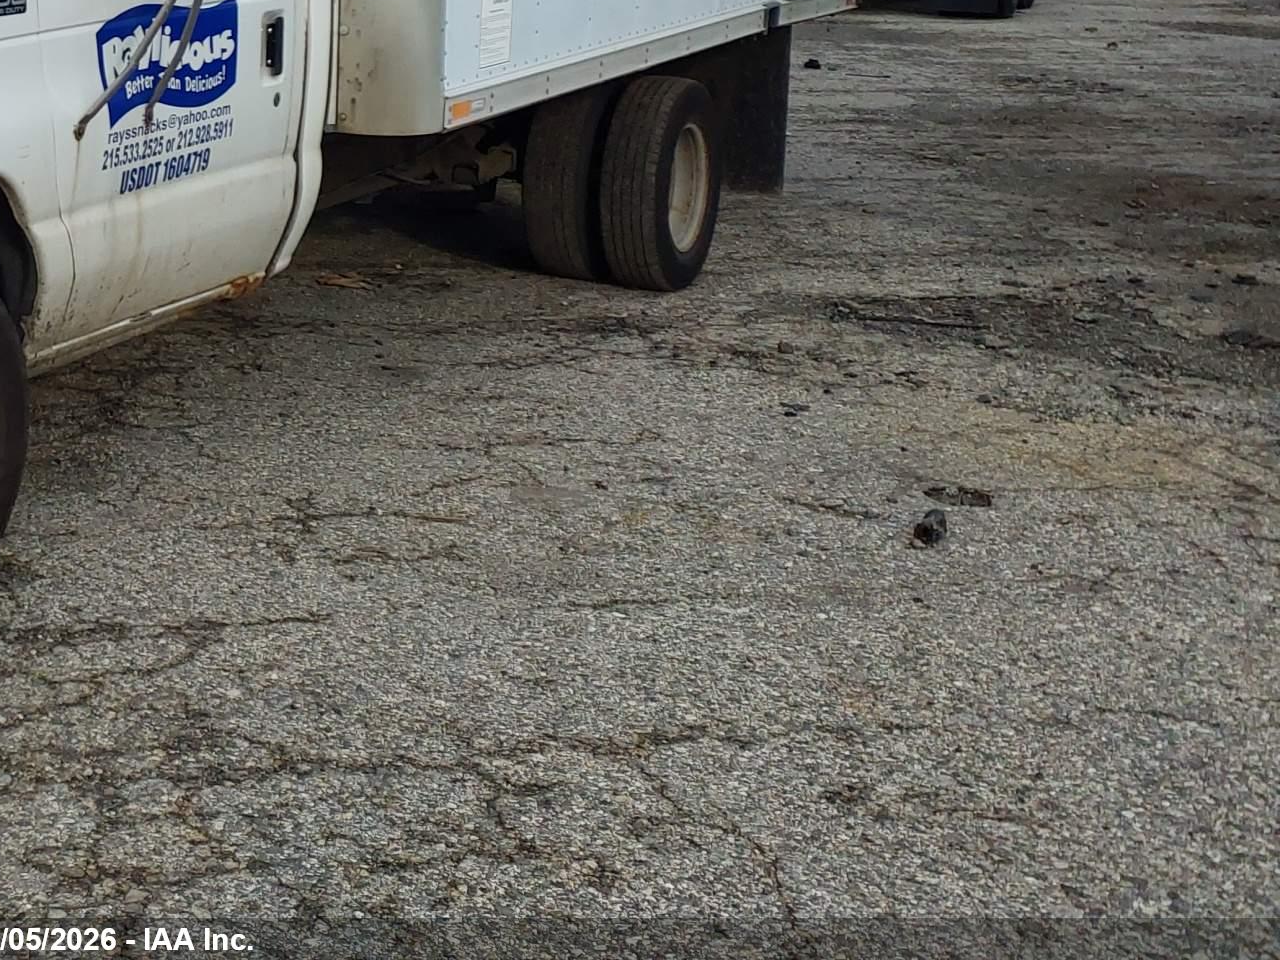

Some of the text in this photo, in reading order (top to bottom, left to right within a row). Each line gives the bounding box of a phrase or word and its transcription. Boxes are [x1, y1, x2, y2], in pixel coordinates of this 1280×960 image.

[124, 74, 155, 100] Better
[184, 63, 226, 93] Delicious!
[101, 118, 234, 171] 215.533.2525 or 212.928.5911
[107, 104, 232, 146] rayssnacks@yahoo.com
[120, 147, 211, 195] USDOT 1604719
